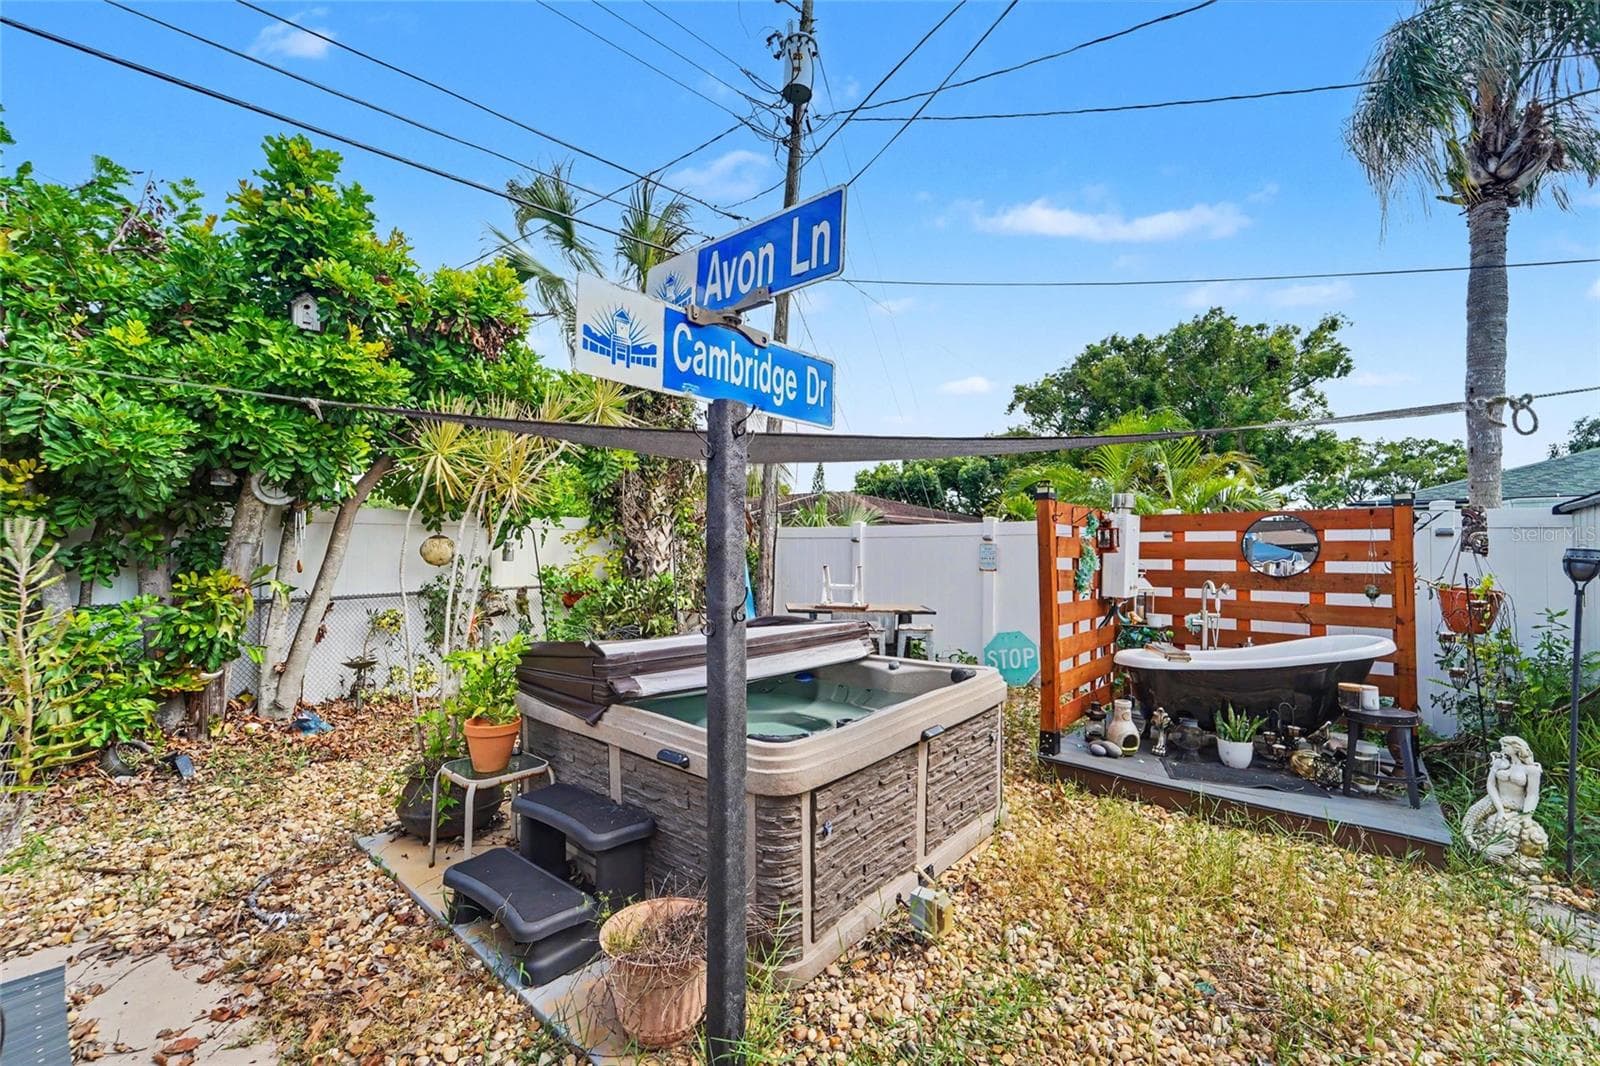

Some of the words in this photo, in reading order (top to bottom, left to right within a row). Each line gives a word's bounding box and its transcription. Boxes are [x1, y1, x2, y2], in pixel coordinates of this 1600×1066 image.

[703, 242, 774, 306] Avon
[790, 217, 831, 276] Ln
[673, 323, 797, 406] Cambridge
[805, 366, 827, 407] Dr
[987, 648, 1034, 669] STOP
